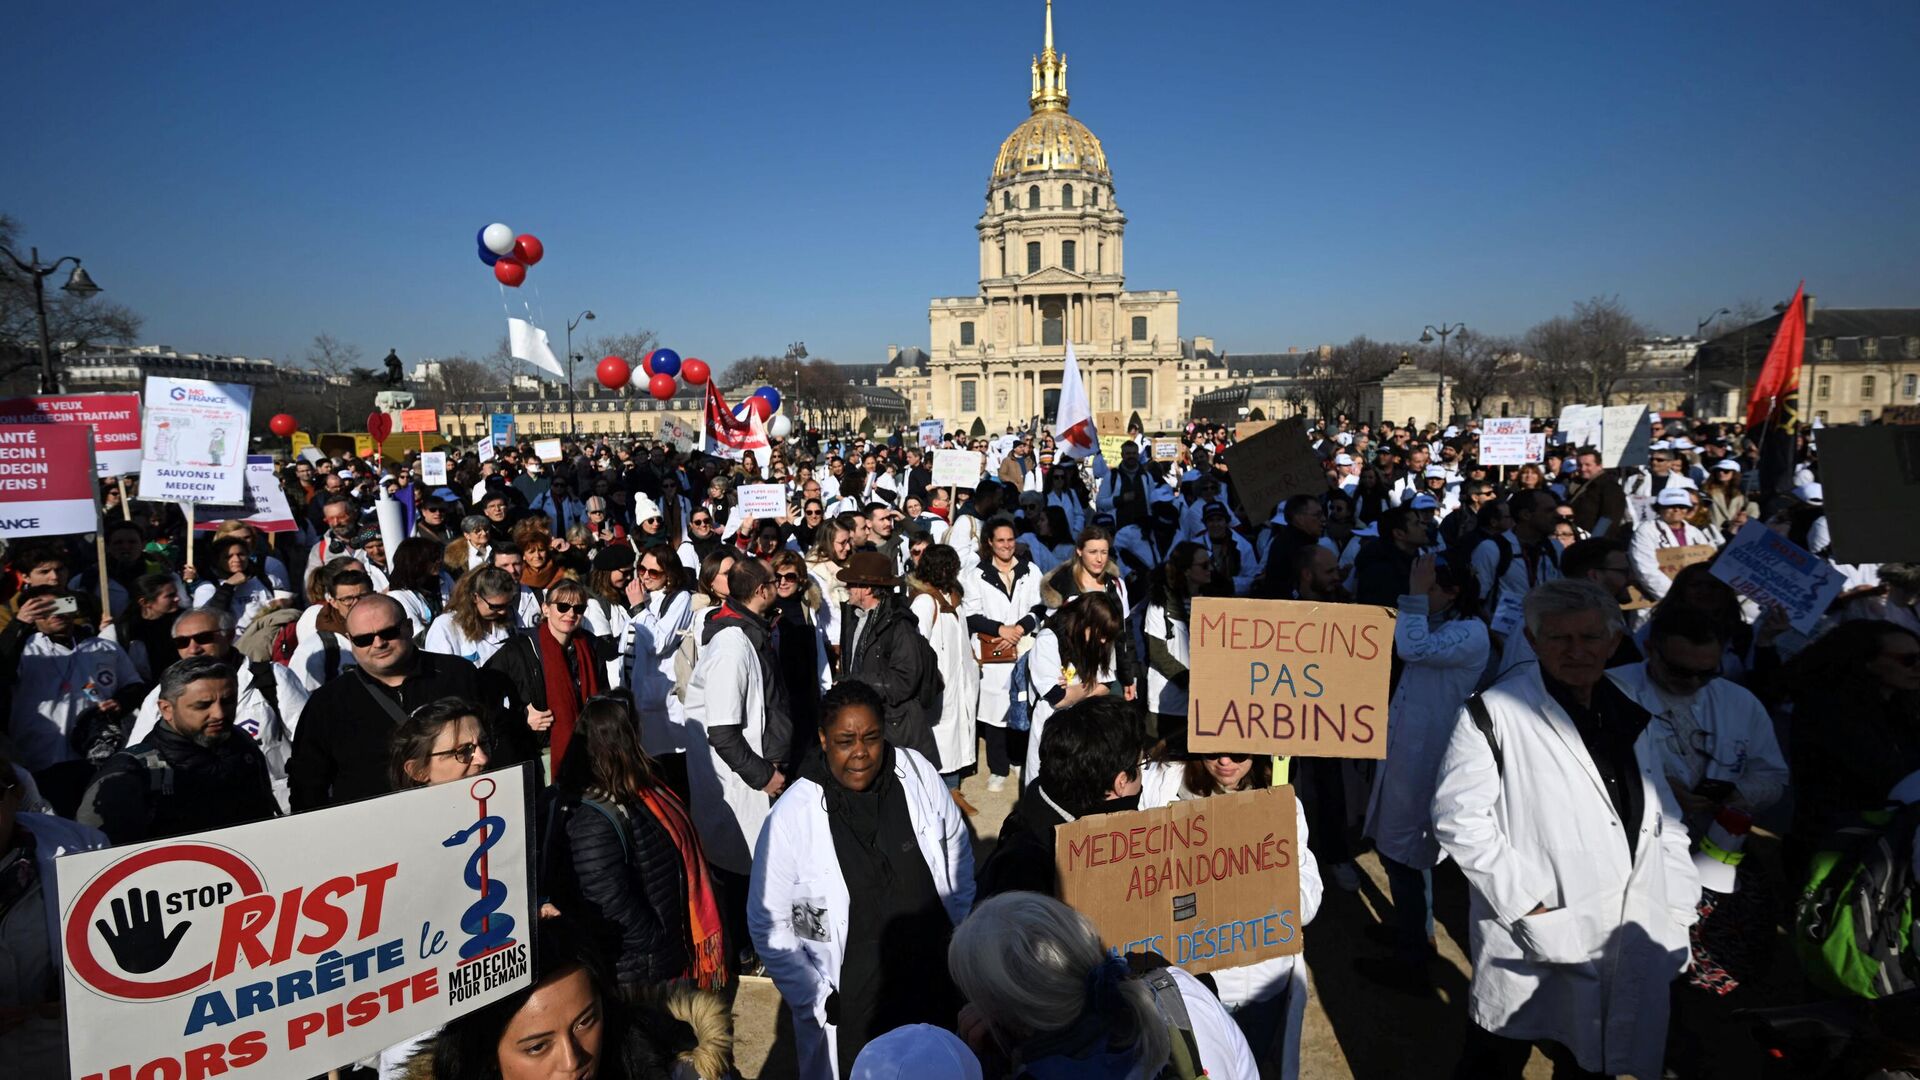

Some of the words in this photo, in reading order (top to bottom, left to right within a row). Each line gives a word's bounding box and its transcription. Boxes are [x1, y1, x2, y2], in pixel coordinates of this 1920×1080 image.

[37, 401, 50, 411] JE
[51, 401, 83, 411] VEUX
[187, 394, 229, 404] FRANCE
[188, 388, 205, 396] MG
[20, 411, 74, 423] MÉDECIN
[76, 410, 131, 421] TRAITANT
[104, 432, 138, 443] SOINS
[157, 468, 211, 479] SAUVONS
[213, 472, 225, 480] LE
[165, 481, 216, 491] MEDECIN
[1200, 611, 1379, 661] MEDECINS
[1250, 662, 1324, 698] PAS
[1194, 698, 1375, 744] LARBINS
[1068, 814, 1209, 871] MEDECINS
[1126, 832, 1291, 902] ABANDONNÉS
[166, 882, 234, 915] STOP
[213, 862, 399, 981] RIST
[184, 938, 405, 1036] ARRÊTE
[419, 921, 449, 959] le
[448, 944, 527, 990] MEDECINS
[448, 982, 481, 1006] POUR
[484, 960, 528, 989] DEMAIN
[288, 967, 439, 1051] PISTE
